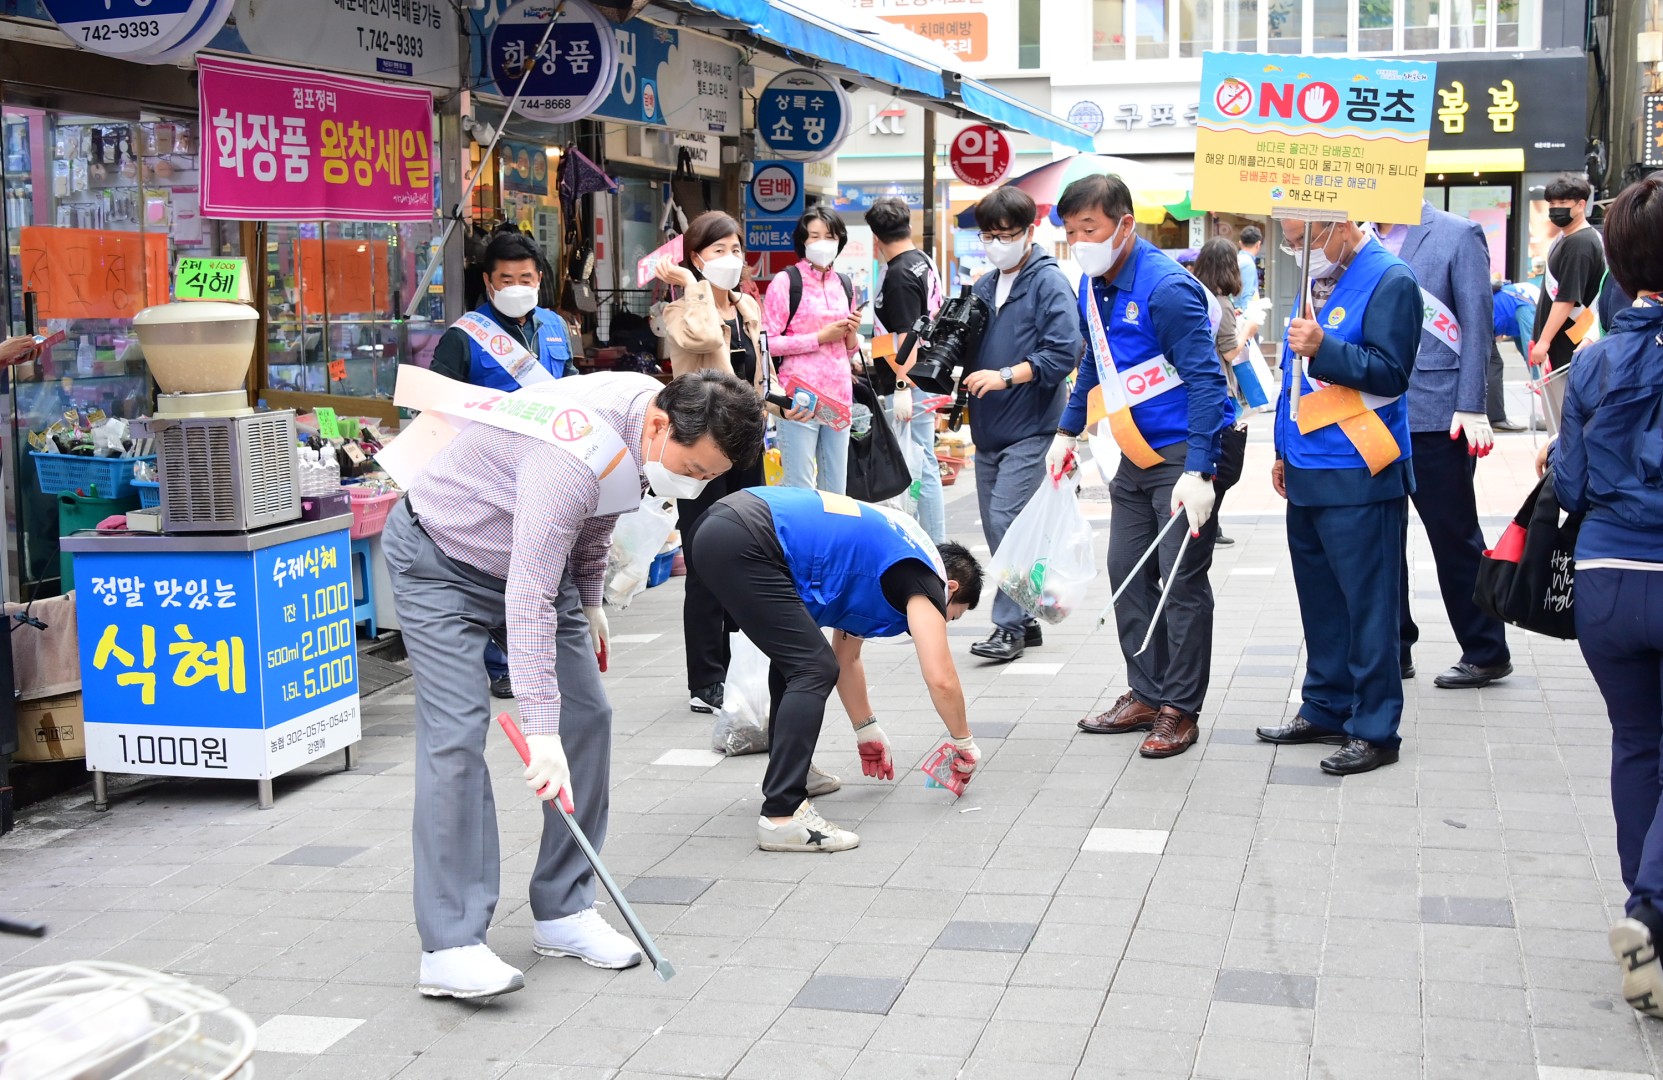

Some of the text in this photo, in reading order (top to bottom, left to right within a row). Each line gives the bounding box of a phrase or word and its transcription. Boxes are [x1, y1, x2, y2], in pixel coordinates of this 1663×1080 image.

[82, 21, 159, 41] 742-9393
[920, 21, 972, 36] 치매예방
[357, 26, 423, 58] T.742-9393
[293, 88, 337, 113] 점포정리
[520, 99, 571, 109] 744-8668
[776, 95, 824, 111] 상록수
[1258, 81, 1415, 124] NO 꽁초
[770, 116, 825, 144] 쇼핑
[868, 104, 906, 135] kt
[212, 108, 311, 182] 화장품
[320, 119, 430, 189] 왕창세일
[958, 130, 999, 173] 약
[1257, 142, 1285, 153] 바다로
[1322, 145, 1365, 158] 담배꽁초!
[1205, 153, 1418, 177] 해양 미세플라스틱이 되어 물고기 먹이가 됩니다
[758, 178, 791, 196] 담배
[1240, 170, 1376, 189] 담배꽁초 없는 아름다운 해운대
[1288, 189, 1337, 203] 해운대구
[749, 231, 792, 247] 하이트소
[185, 272, 234, 297] 식혜
[273, 546, 337, 588] 수제식혜
[92, 576, 237, 611] 정말 맛있는
[283, 582, 349, 623] 1잔 1.000
[267, 619, 351, 669] 500ml 2.000
[93, 623, 247, 705] 식혜
[282, 654, 353, 702] 1.5L 5.000
[118, 733, 228, 769] 1.000원
[270, 735, 285, 753] 농협
